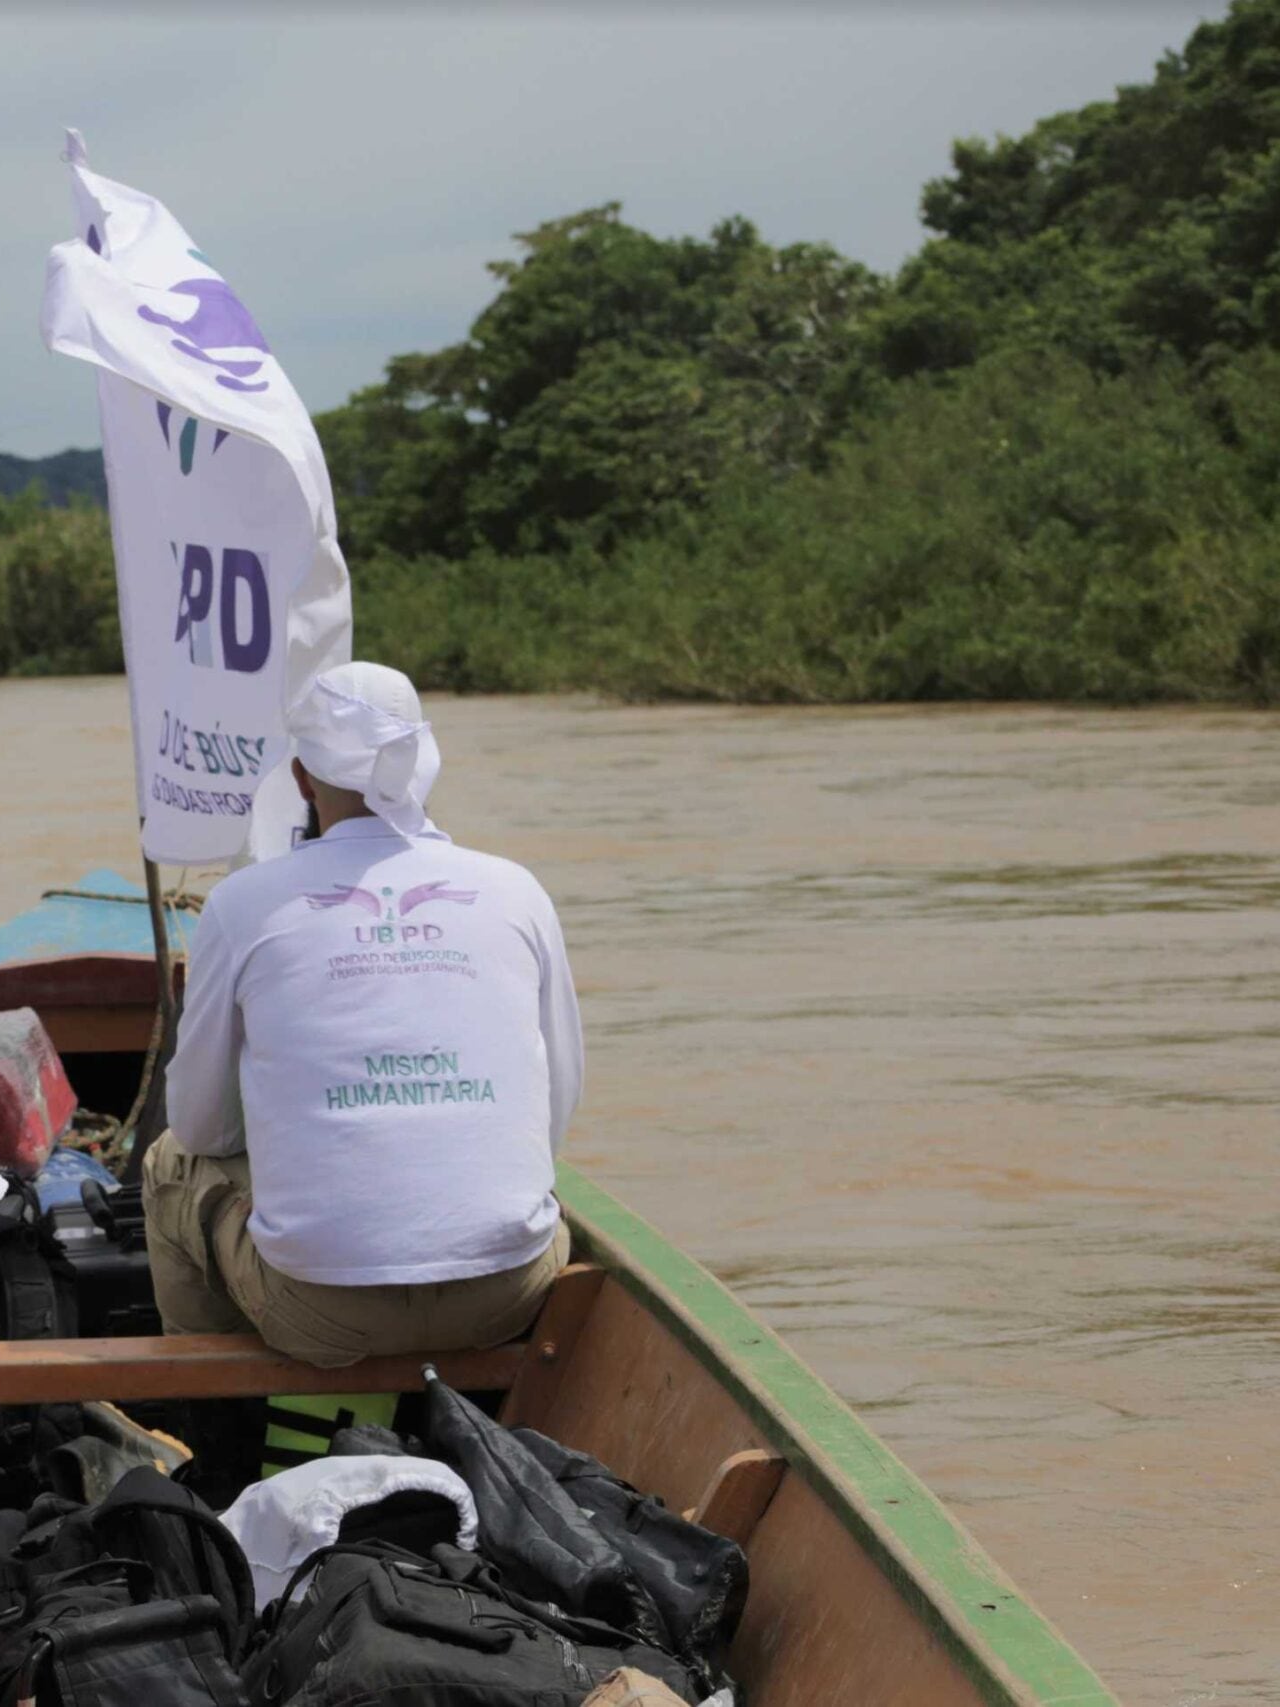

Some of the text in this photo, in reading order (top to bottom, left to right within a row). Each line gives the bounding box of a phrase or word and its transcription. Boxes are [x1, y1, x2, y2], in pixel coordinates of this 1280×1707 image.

[355, 923, 443, 944] UBPD
[383, 952, 400, 963] DE
[364, 1046, 459, 1077] MISIÓN
[326, 1079, 495, 1110] HUMANITARIA
